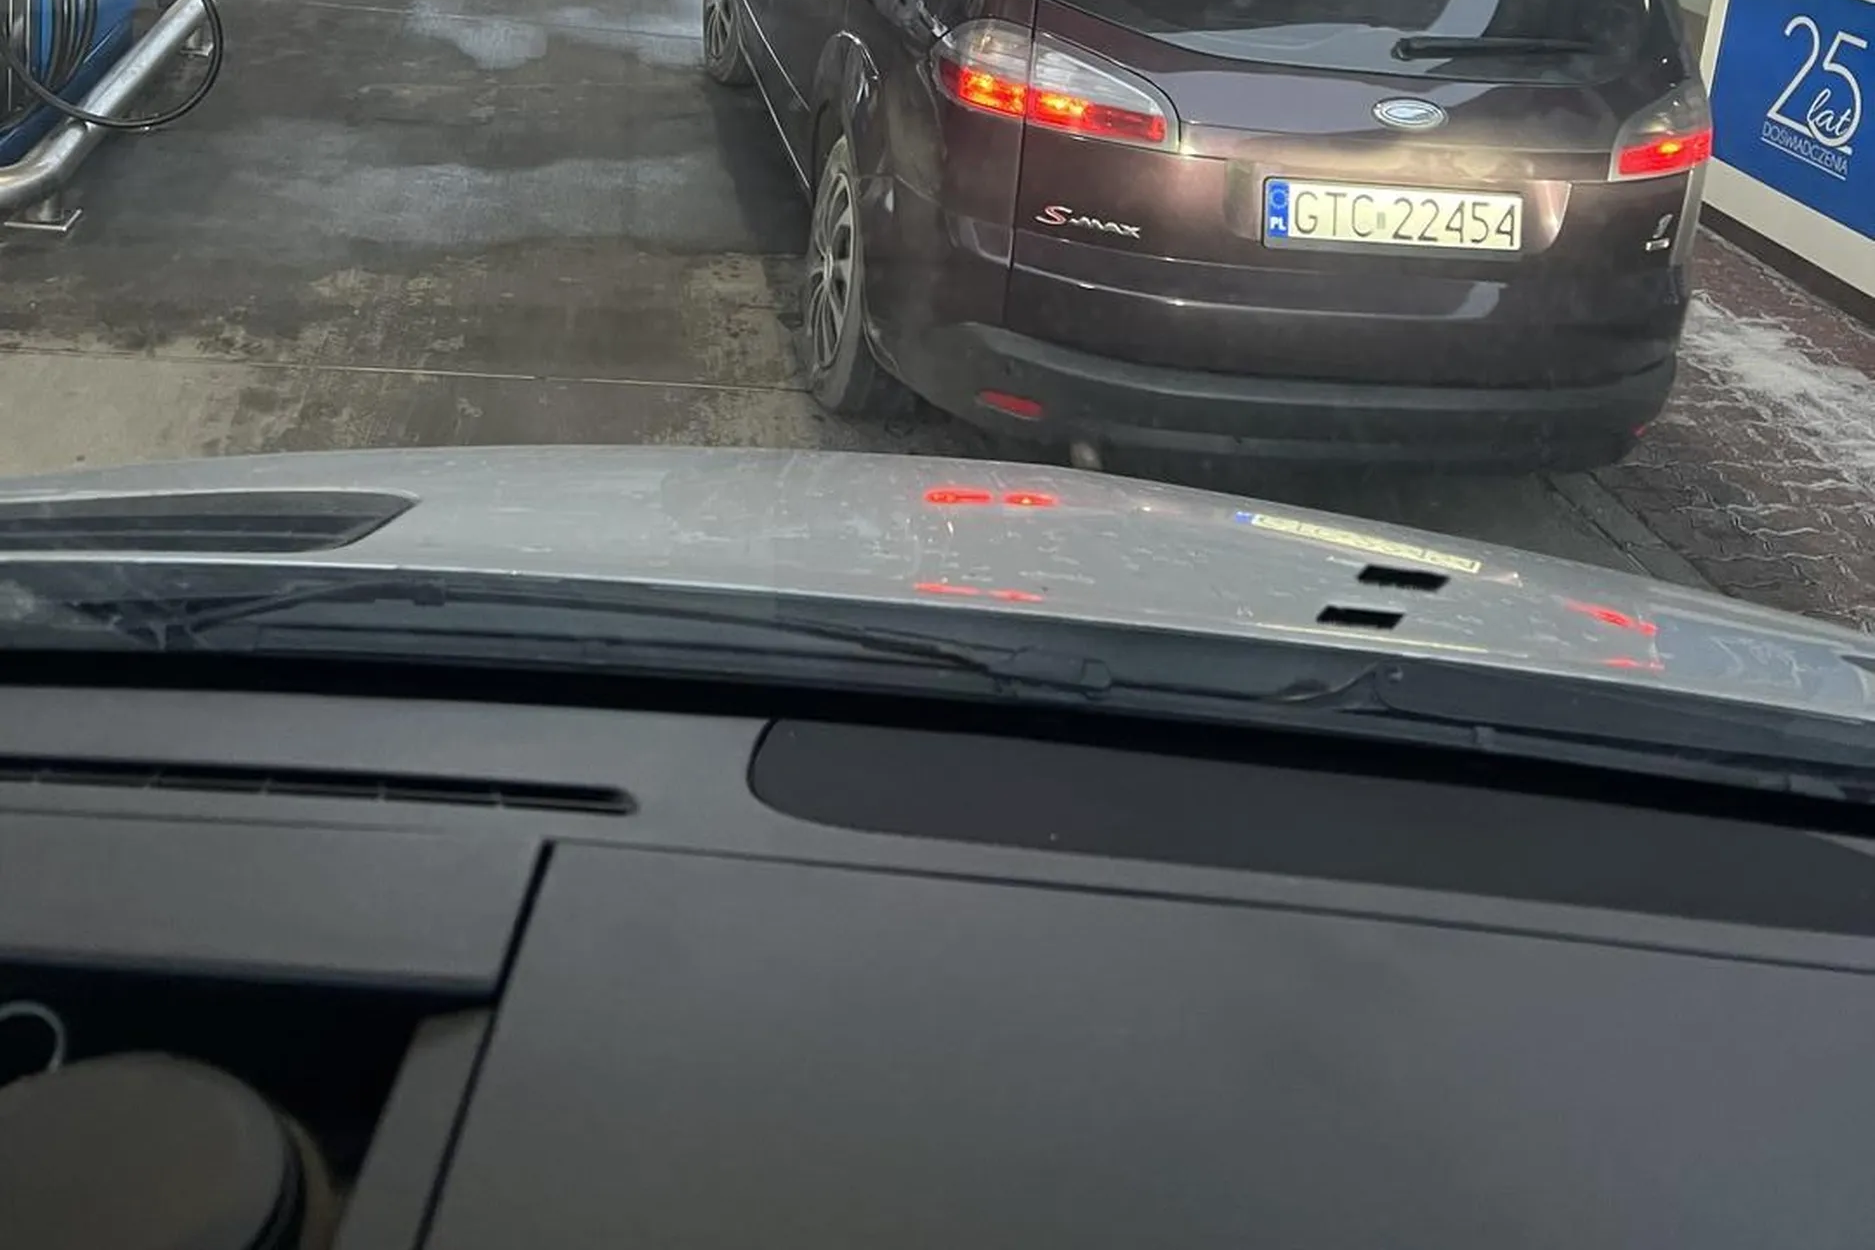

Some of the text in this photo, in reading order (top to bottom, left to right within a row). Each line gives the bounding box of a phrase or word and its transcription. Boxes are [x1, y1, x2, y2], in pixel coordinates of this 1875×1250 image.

[1767, 15, 1868, 155] 25
[1807, 88, 1851, 136] lat
[1270, 216, 1287, 231] PL
[1294, 191, 1516, 247] GTC 22454
